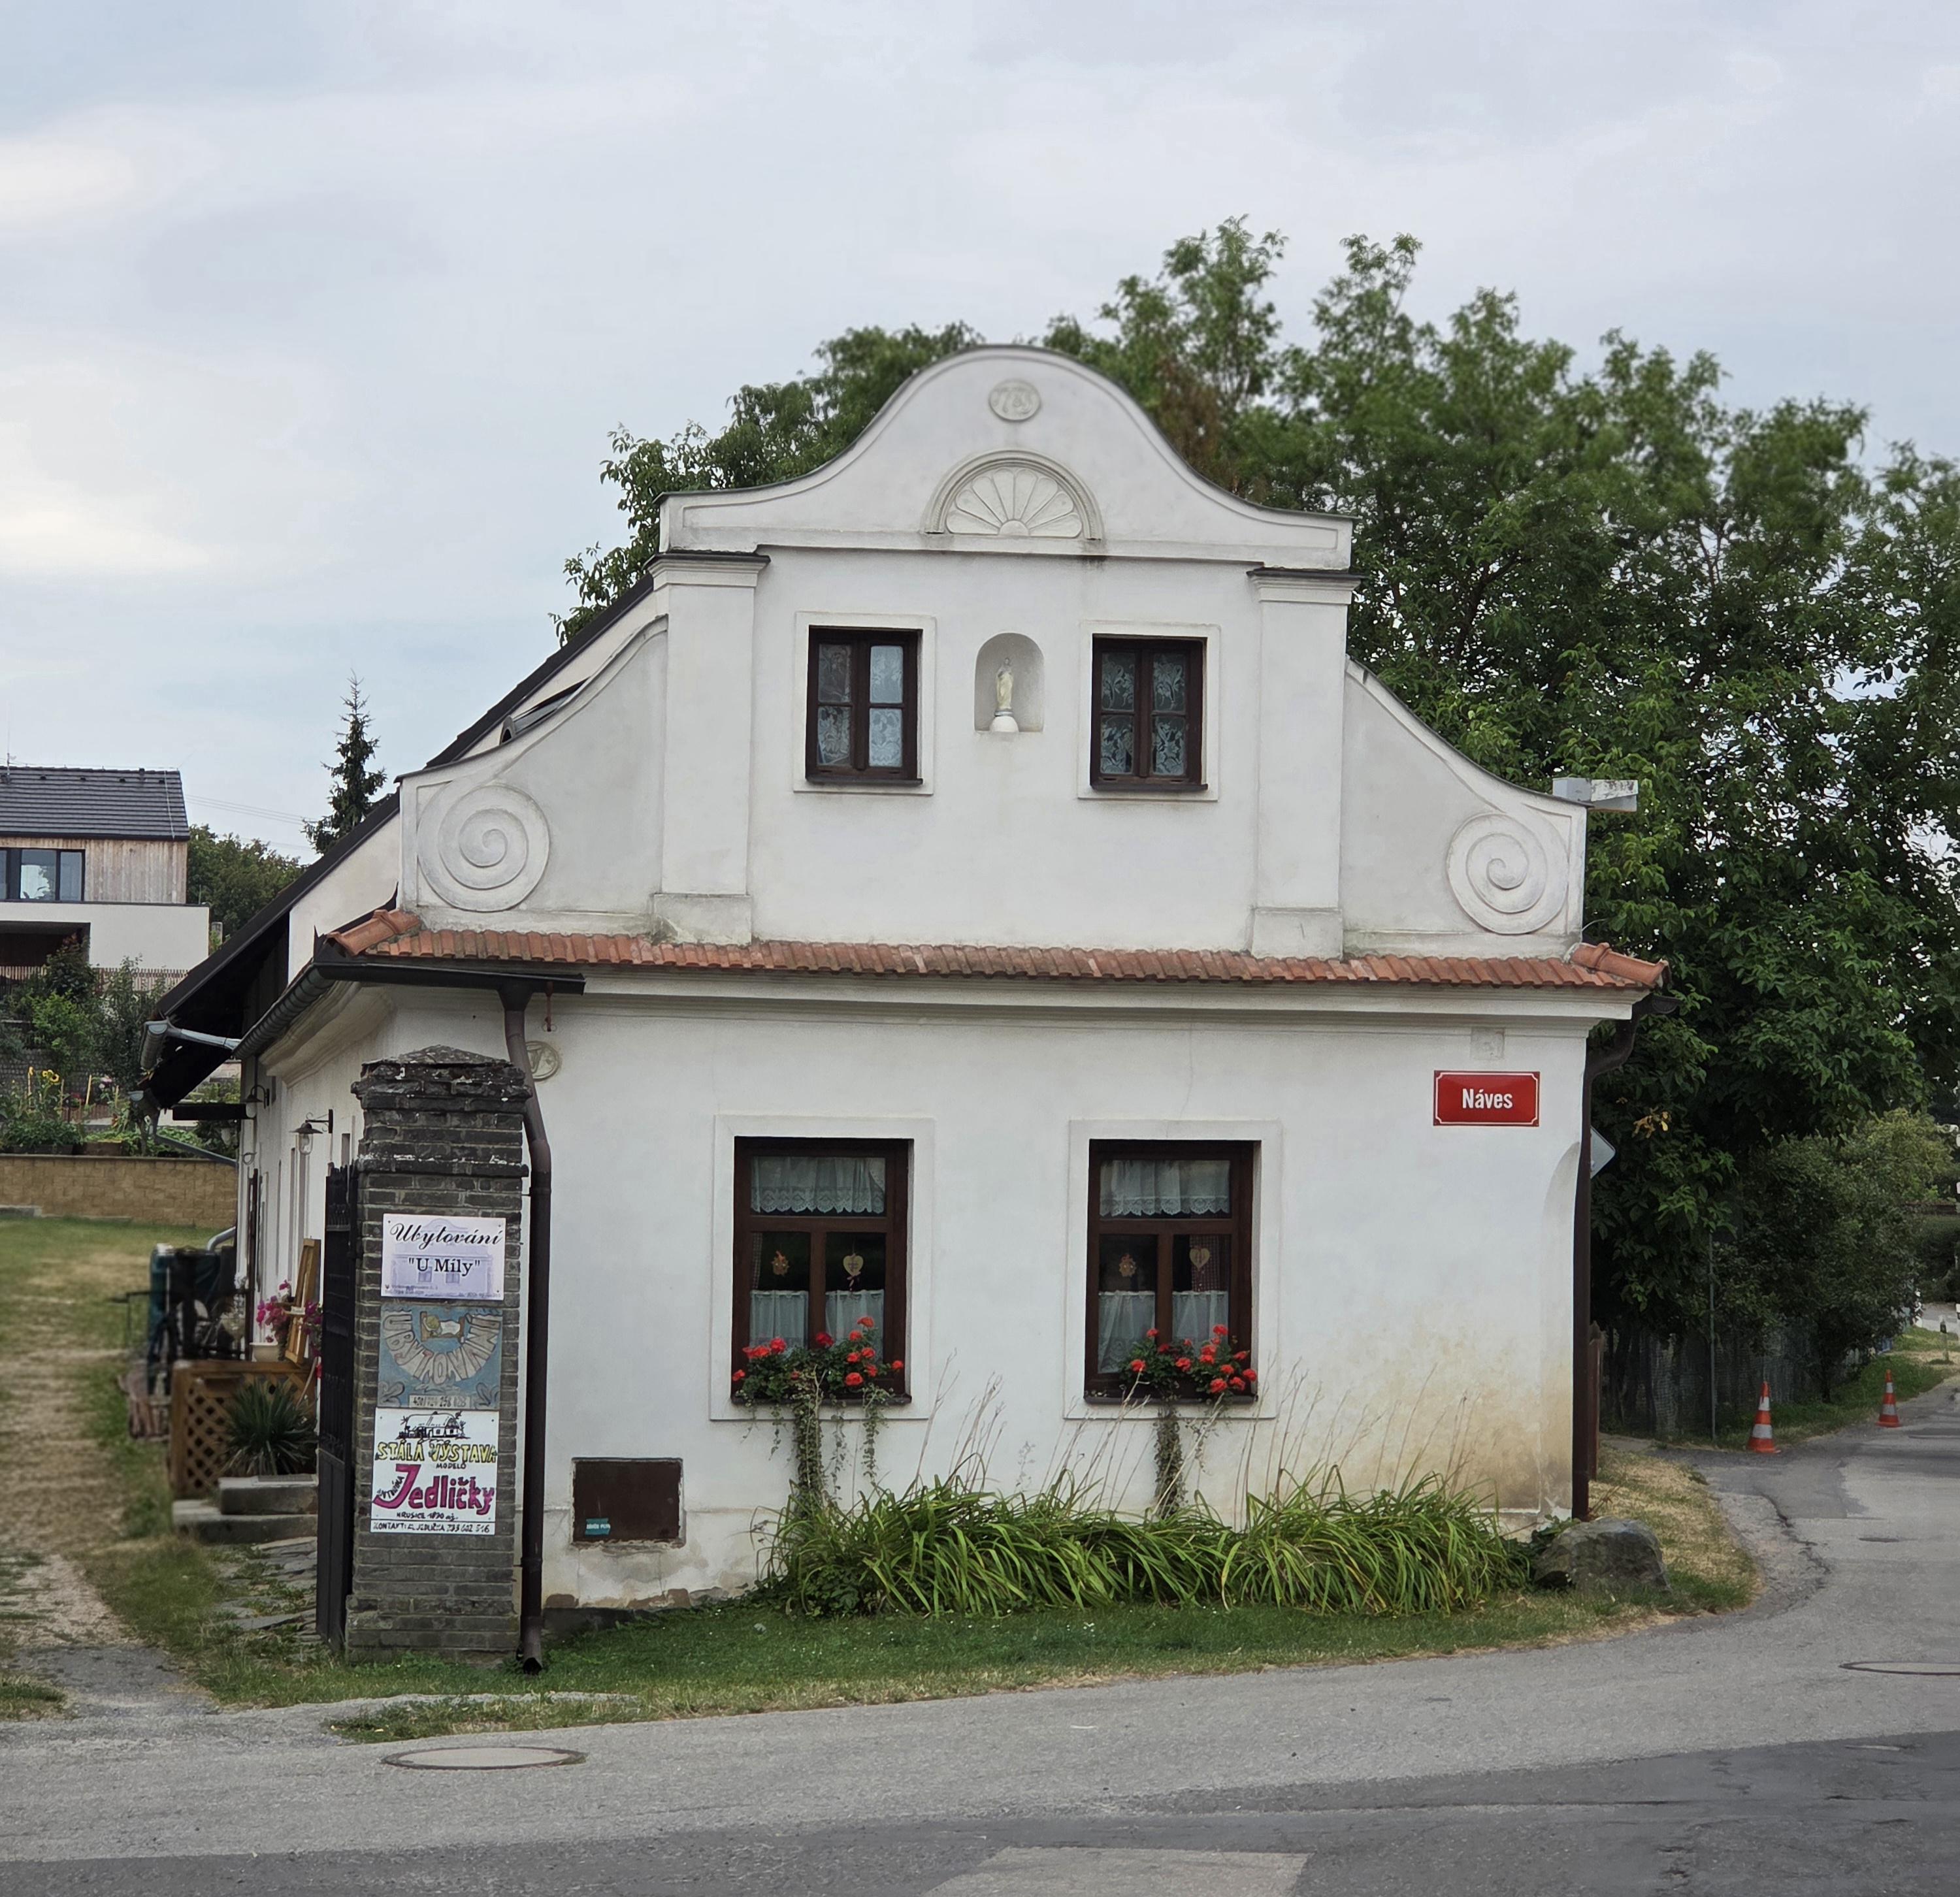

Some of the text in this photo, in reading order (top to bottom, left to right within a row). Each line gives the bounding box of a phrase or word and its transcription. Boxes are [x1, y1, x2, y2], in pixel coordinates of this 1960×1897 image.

[1462, 1088, 1512, 1109] Náves
[390, 1223, 503, 1250] Ubytování
[408, 1257, 480, 1276] "U Míly"
[376, 1439, 497, 1463] STÁLÁ VÝSTAVA
[372, 1464, 495, 1516] Jedličky
